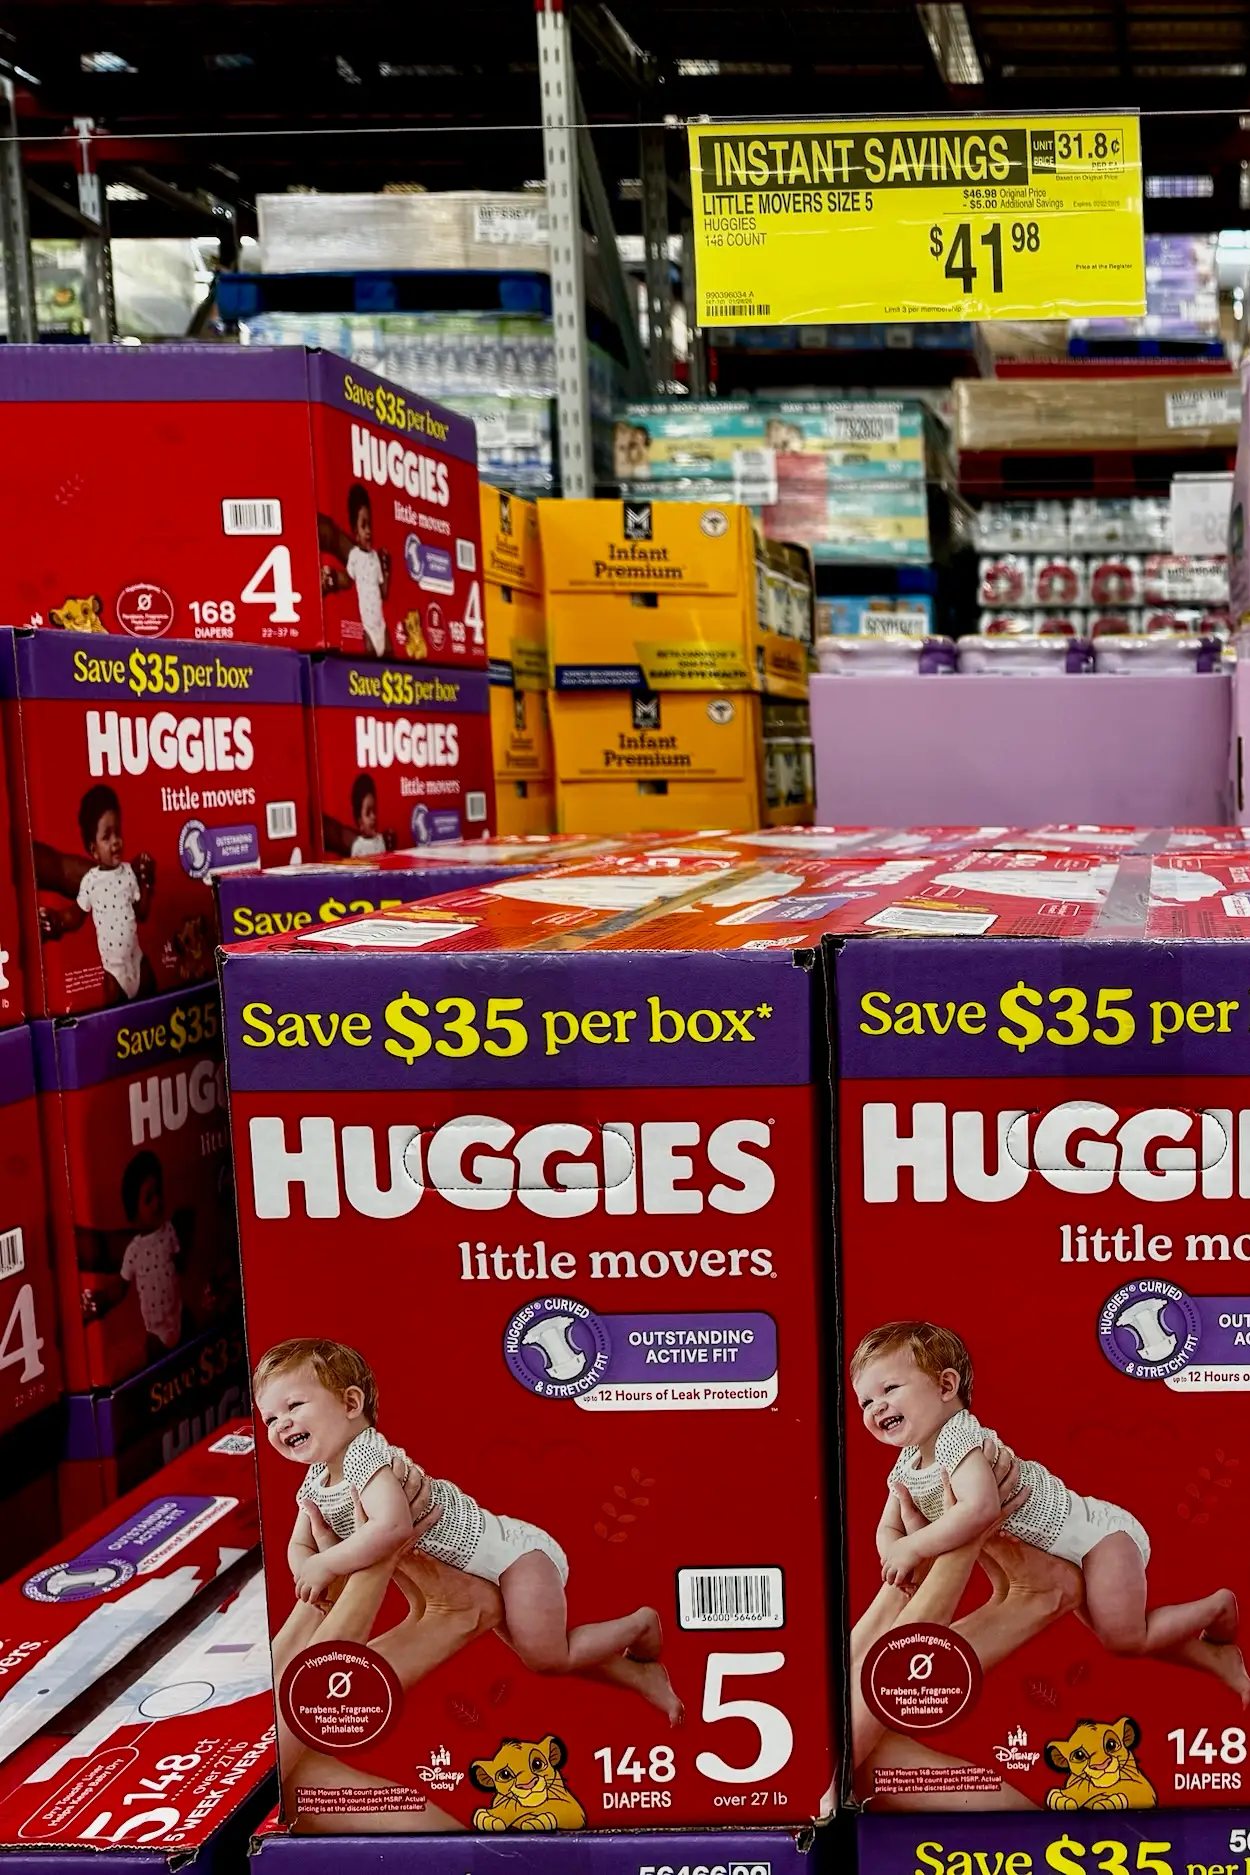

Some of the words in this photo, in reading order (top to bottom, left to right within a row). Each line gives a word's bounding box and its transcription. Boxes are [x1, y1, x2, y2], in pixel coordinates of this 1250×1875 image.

[1033, 140, 1053, 150] UNIT
[713, 140, 854, 186] INSTANT
[865, 135, 1010, 184] SAVINGS
[1033, 157, 1054, 166] PRICE
[703, 194, 754, 215] LITTLE
[759, 193, 823, 214] MOVERS
[828, 192, 860, 212] SIZE
[865, 192, 873, 212] 5
[963, 189, 997, 199] $46.98
[1000, 188, 1027, 198] Original
[1028, 188, 1046, 198] Price
[970, 200, 997, 209] $5.00
[1000, 200, 1035, 208] Additional
[1036, 199, 1064, 209] Savings
[704, 218, 756, 231] HUGGIES
[705, 235, 724, 246] 148
[727, 232, 767, 246] COUNT
[344, 374, 374, 410] Save
[375, 385, 406, 430] $35
[407, 411, 425, 433] per
[351, 423, 449, 507] HUGGIES
[394, 500, 418, 528] little
[418, 510, 450, 537] movers
[609, 544, 670, 562] Infant
[594, 561, 684, 580] Premium
[240, 544, 302, 624] 4
[188, 600, 237, 625] 168
[194, 627, 234, 639] DIAPERS
[73, 650, 126, 685] Save
[128, 648, 180, 698] $35
[182, 662, 212, 692] per
[349, 670, 380, 699] Save
[382, 668, 414, 706] $35
[415, 679, 435, 702] per
[85, 710, 254, 777] HUGGIES
[355, 716, 460, 768] HUGGIES
[618, 732, 677, 751] Infant
[604, 752, 692, 768] Premium
[400, 776, 426, 796] little
[427, 778, 460, 796] movers
[161, 786, 200, 812] little
[202, 786, 256, 810] movers
[233, 906, 313, 937] Save
[241, 1001, 373, 1050] Save
[383, 991, 529, 1067] $35
[543, 1008, 637, 1057] per
[860, 991, 987, 1035] Save
[998, 980, 1135, 1054] $35
[1150, 1000, 1240, 1044] per
[117, 1022, 167, 1060] Save
[248, 1114, 776, 1220] HUGGIES
[1060, 1224, 1173, 1263] little
[459, 1242, 577, 1280] little
[590, 1247, 774, 1280] movers
[628, 1329, 755, 1346] OUTSTANDING
[646, 1348, 709, 1364] ACTIVE
[712, 1348, 739, 1362] FIT
[599, 1390, 613, 1402] 12
[615, 1389, 654, 1402] Hours
[656, 1388, 669, 1401] of
[671, 1388, 701, 1400] Leak
[703, 1386, 768, 1400] Protection
[299, 1705, 340, 1715] Parabens,
[341, 1704, 384, 1715] Fragrance.
[315, 1715, 338, 1724] Made
[338, 1715, 369, 1724] without
[695, 1651, 794, 1784] 5
[321, 1724, 364, 1735] phthalates
[1168, 1727, 1248, 1766] 148
[123, 1753, 202, 1806] 148
[194, 1738, 220, 1754] ct
[192, 1766, 222, 1795] over
[220, 1754, 236, 1769] 27
[233, 1740, 250, 1753] lb
[416, 1766, 466, 1787] Disney
[594, 1744, 676, 1785] 148
[430, 1782, 455, 1792] baby
[1174, 1772, 1242, 1790] DIAPERS
[602, 1791, 672, 1810] DIAPERS
[714, 1794, 748, 1807] over
[750, 1792, 769, 1806] 27
[773, 1791, 788, 1806] lb
[77, 1807, 180, 1842] 5
[163, 1826, 186, 1842] 5
[178, 1786, 230, 1832] WEEK
[914, 1841, 1034, 1875] Save
[1045, 1834, 1174, 1875] $35
